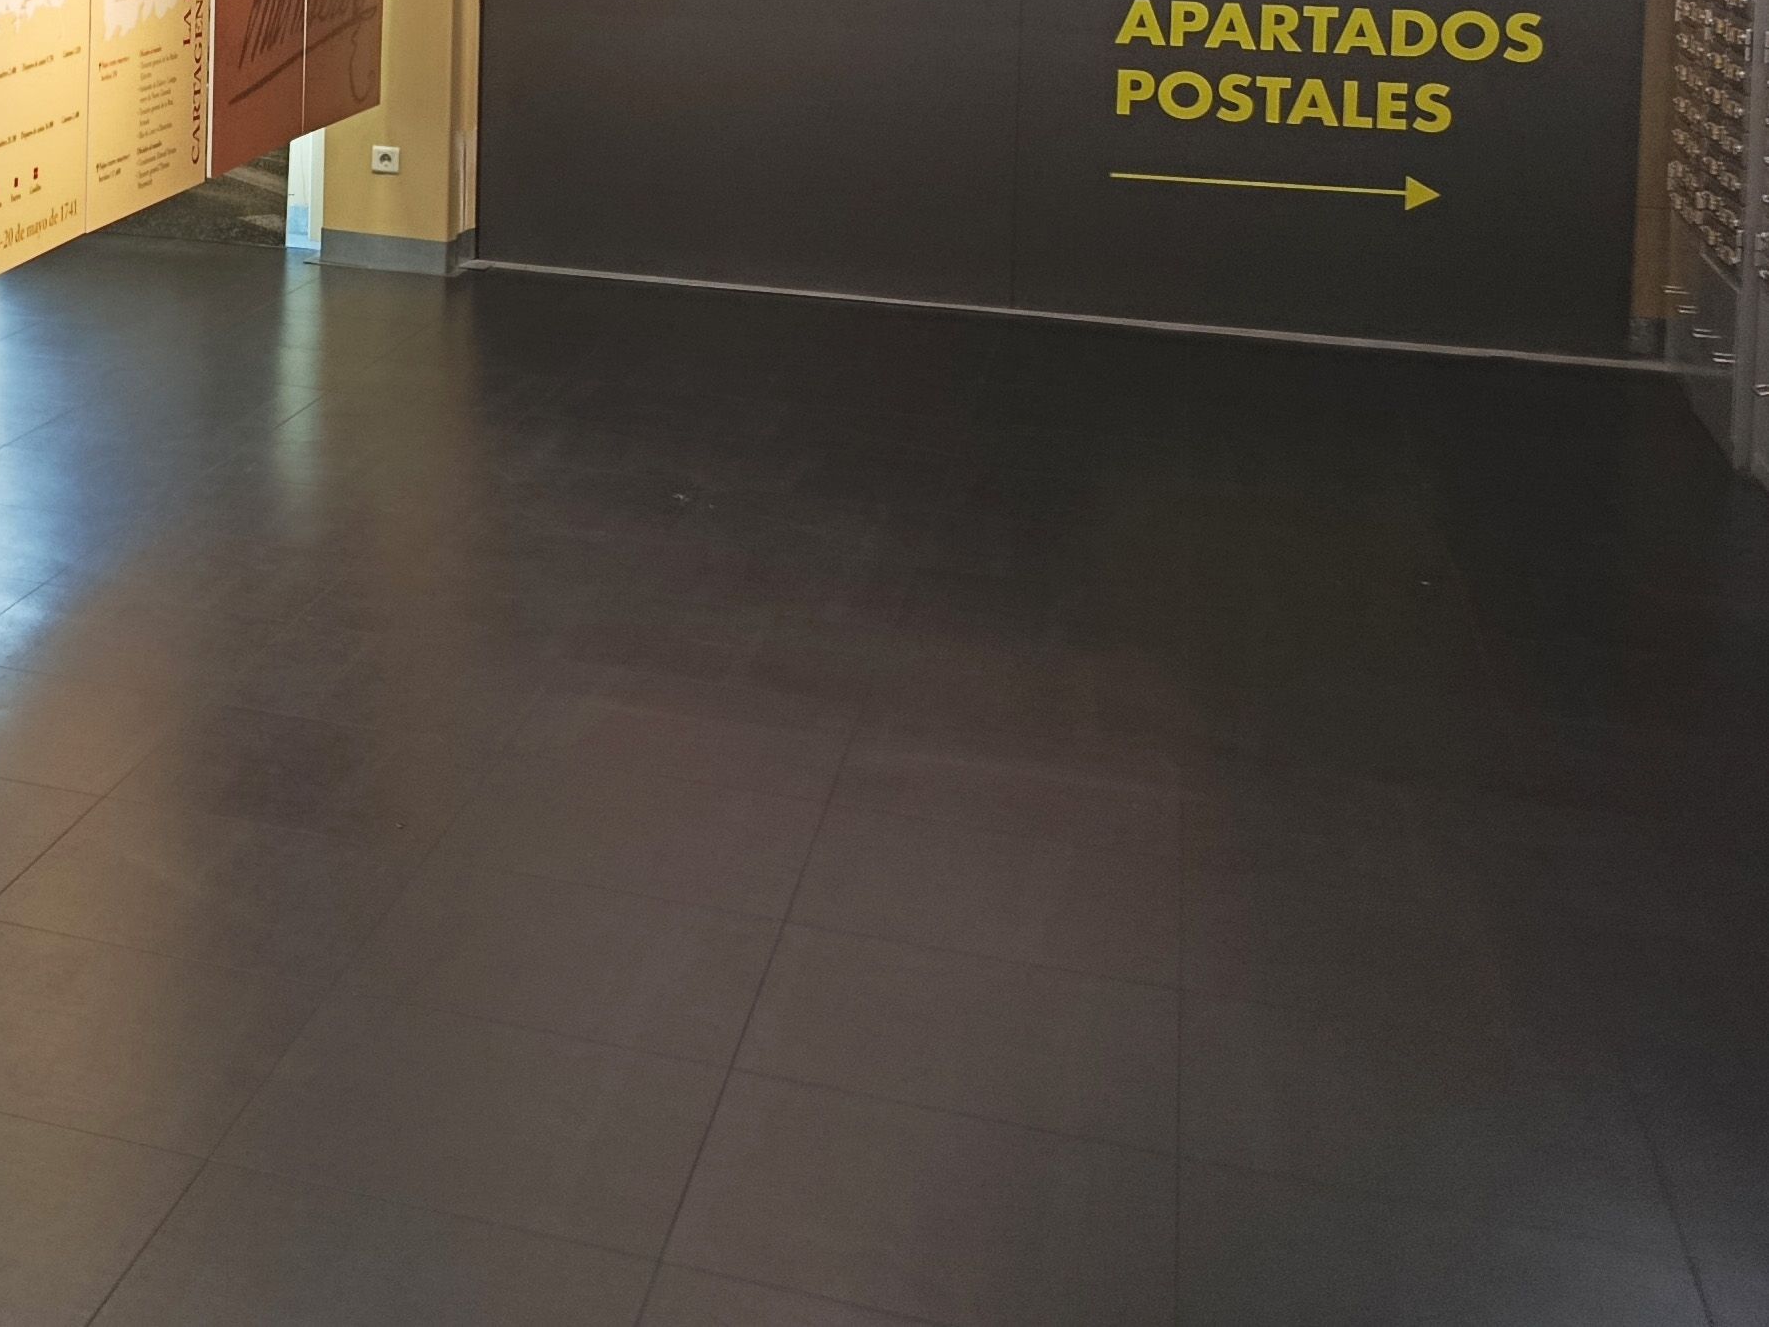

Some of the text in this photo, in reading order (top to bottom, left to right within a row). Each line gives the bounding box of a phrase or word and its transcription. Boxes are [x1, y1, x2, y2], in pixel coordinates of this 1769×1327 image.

[1115, 0, 1544, 63] APARTADOS
[1116, 69, 1453, 133] POSTALES
[15, 223, 25, 243] de
[26, 218, 47, 238] mayo
[49, 207, 59, 227] de
[60, 199, 77, 222] 1741
